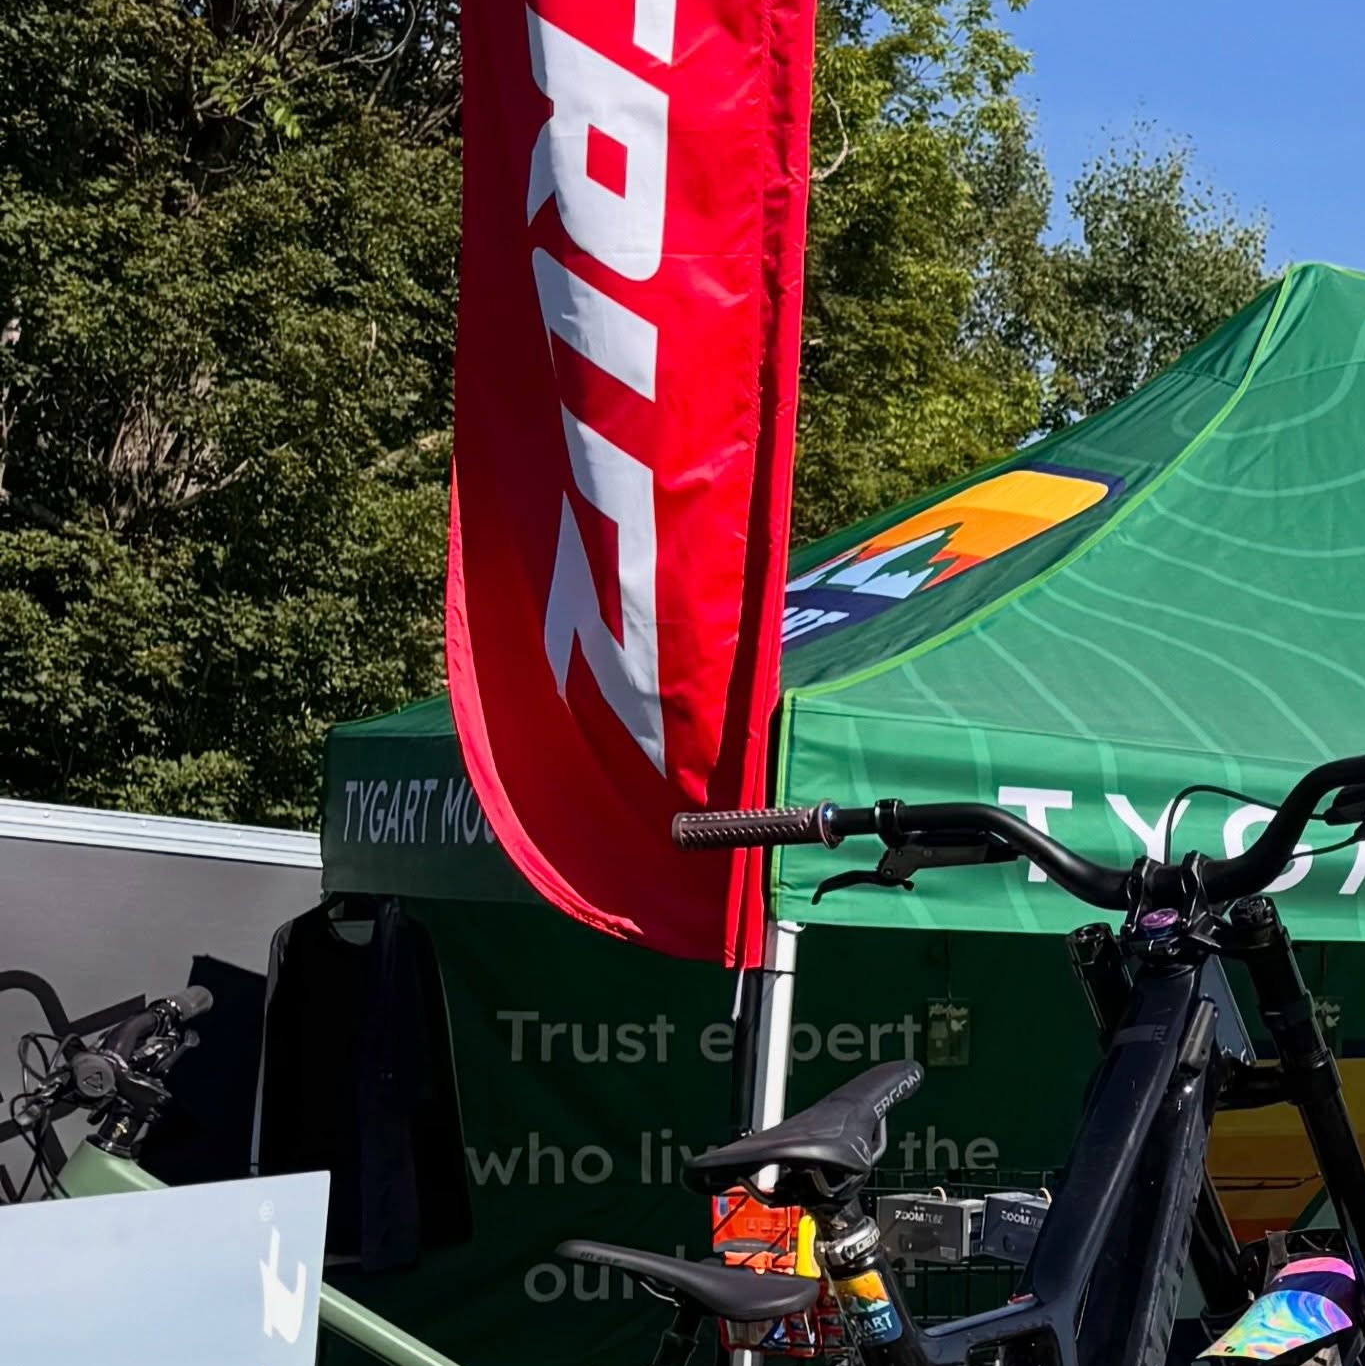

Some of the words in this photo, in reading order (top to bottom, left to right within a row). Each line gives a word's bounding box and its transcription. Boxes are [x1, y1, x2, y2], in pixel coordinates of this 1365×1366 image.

[344, 778, 438, 844] TYGART
[496, 1011, 675, 1064] Trust
[700, 1013, 922, 1075] epert
[464, 1132, 614, 1186] who
[899, 1123, 1000, 1171] the
